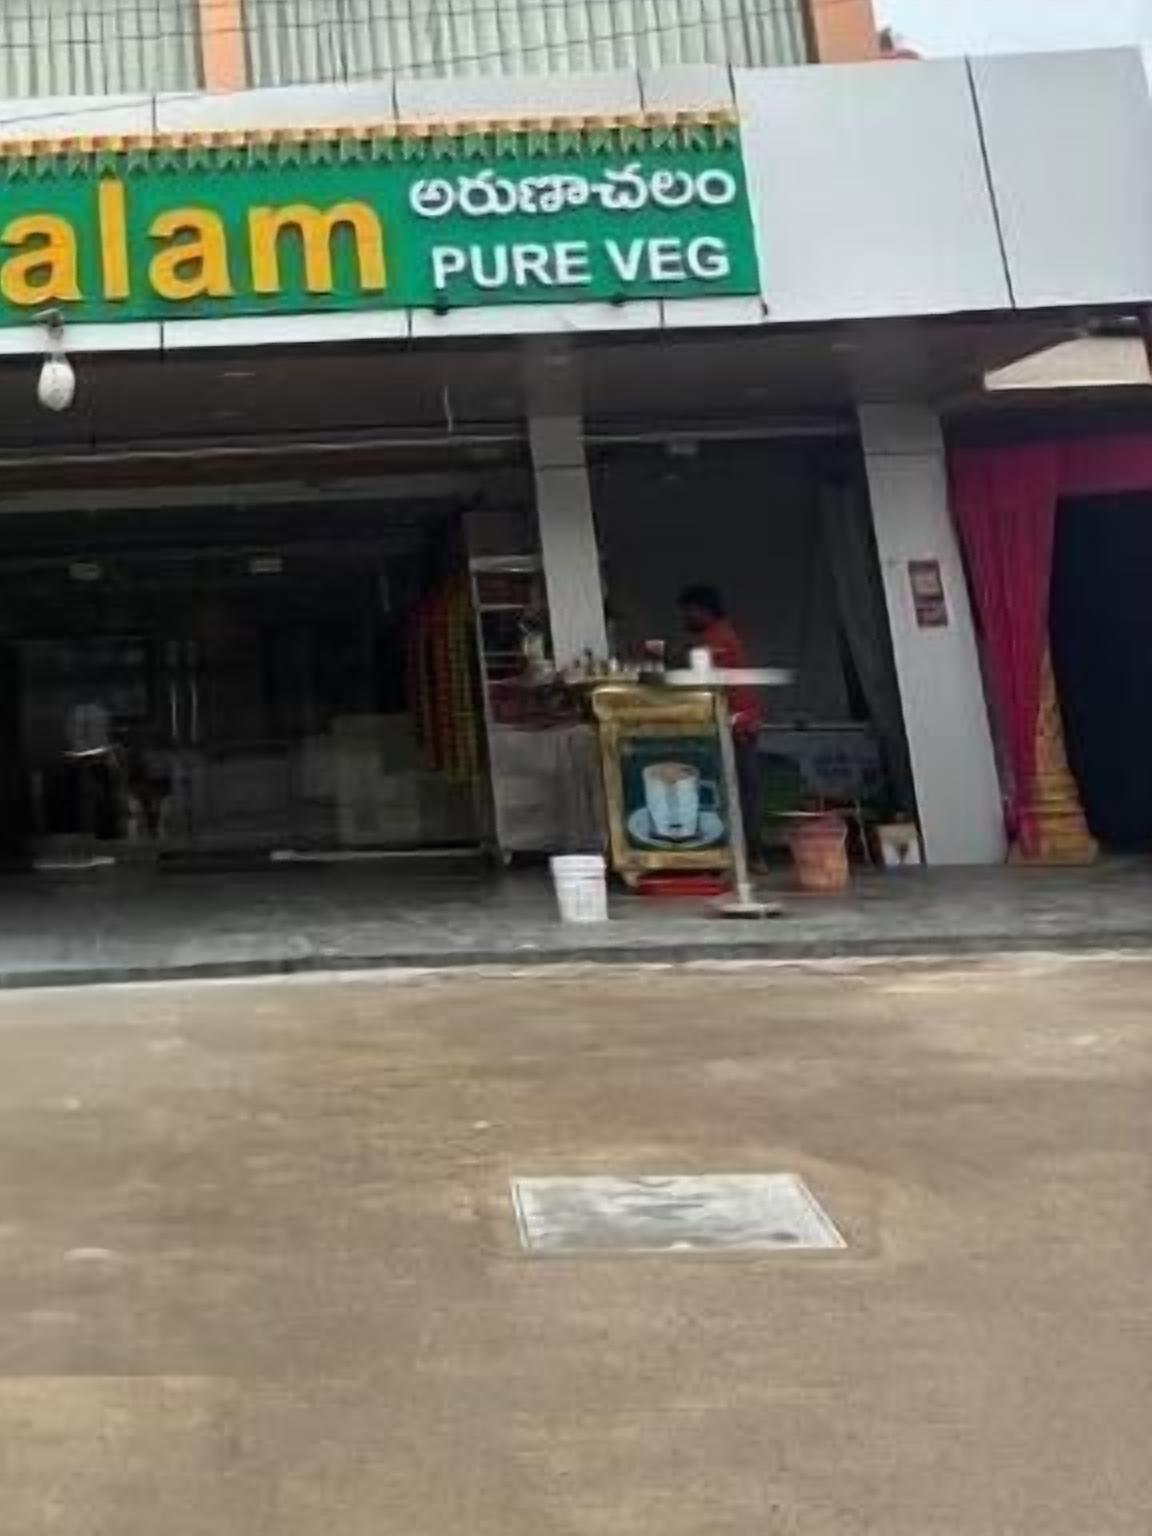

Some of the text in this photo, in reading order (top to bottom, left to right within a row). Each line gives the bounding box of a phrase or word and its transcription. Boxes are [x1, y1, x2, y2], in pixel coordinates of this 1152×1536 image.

[409, 162, 737, 217] అరుణాచలం
[432, 235, 732, 290] PURE VEG
